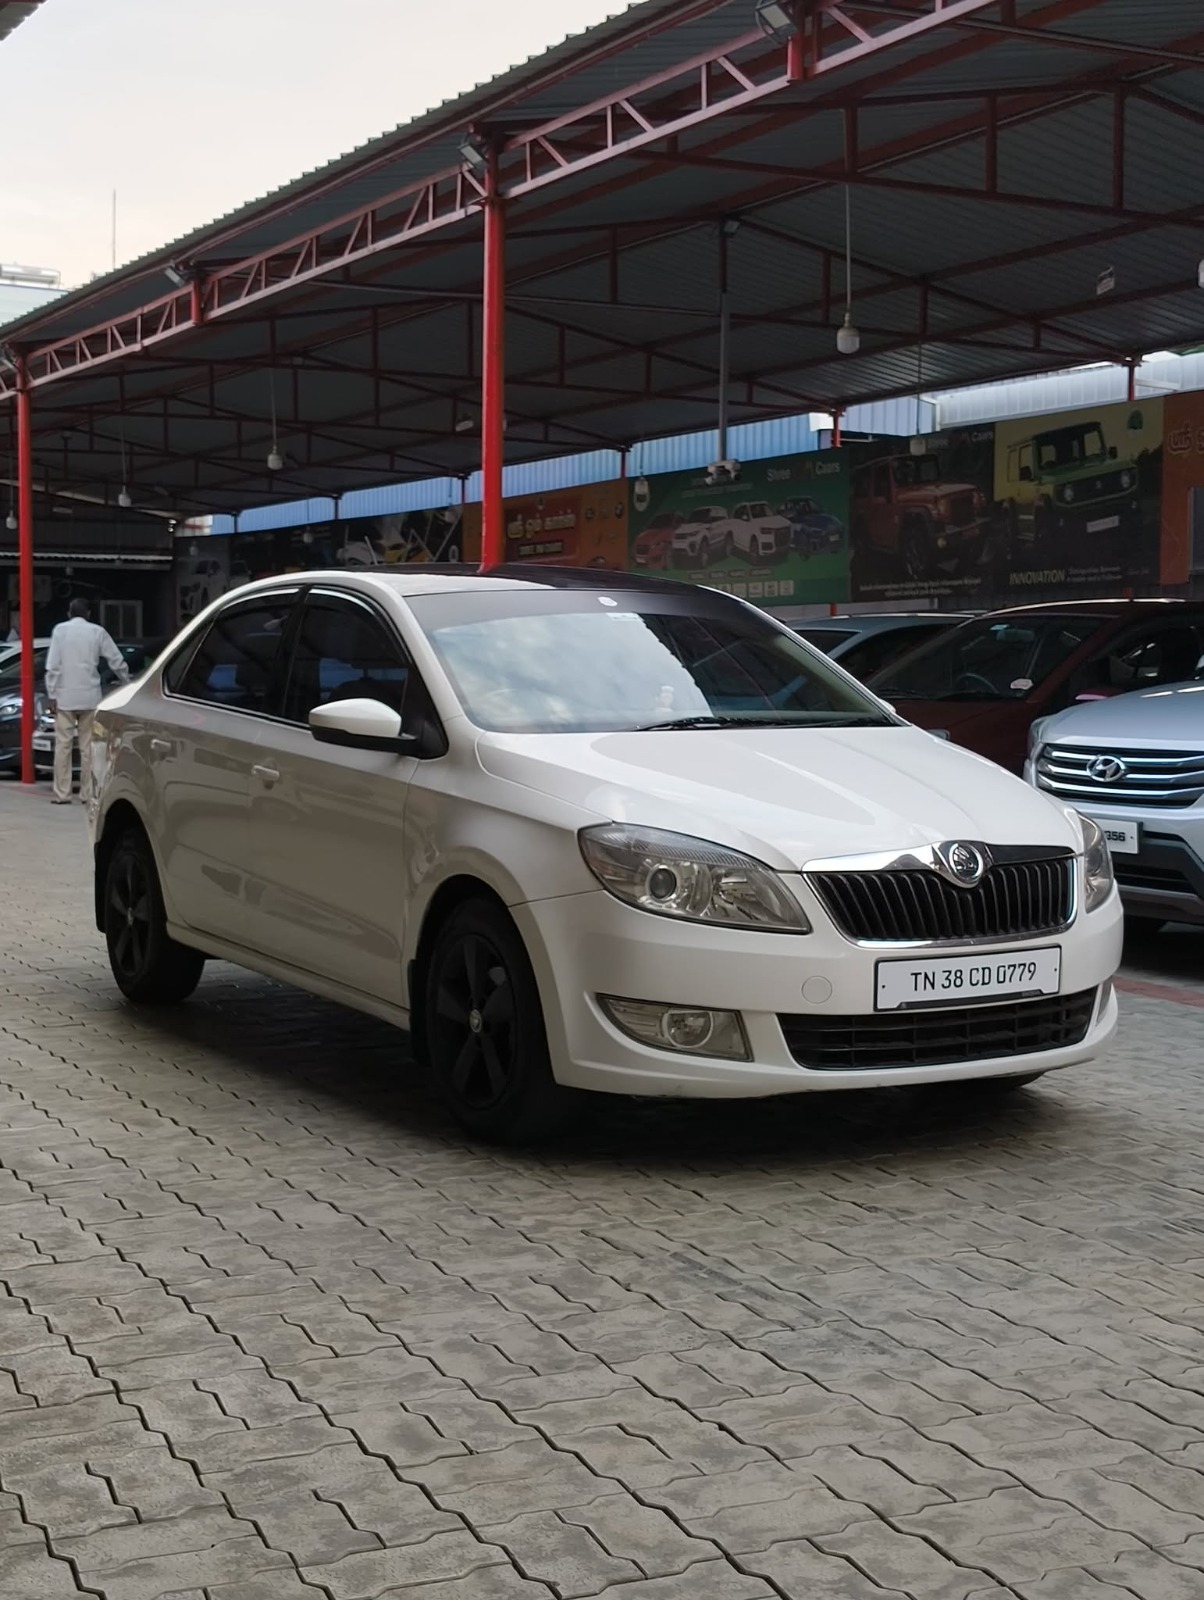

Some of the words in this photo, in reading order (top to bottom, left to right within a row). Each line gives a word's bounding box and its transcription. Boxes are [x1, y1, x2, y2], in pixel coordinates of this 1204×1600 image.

[1009, 569, 1065, 585] INNOVATION
[910, 971, 936, 992] TN
[941, 969, 964, 989] 38
[969, 966, 992, 987] CD
[996, 962, 1037, 984] 0779
